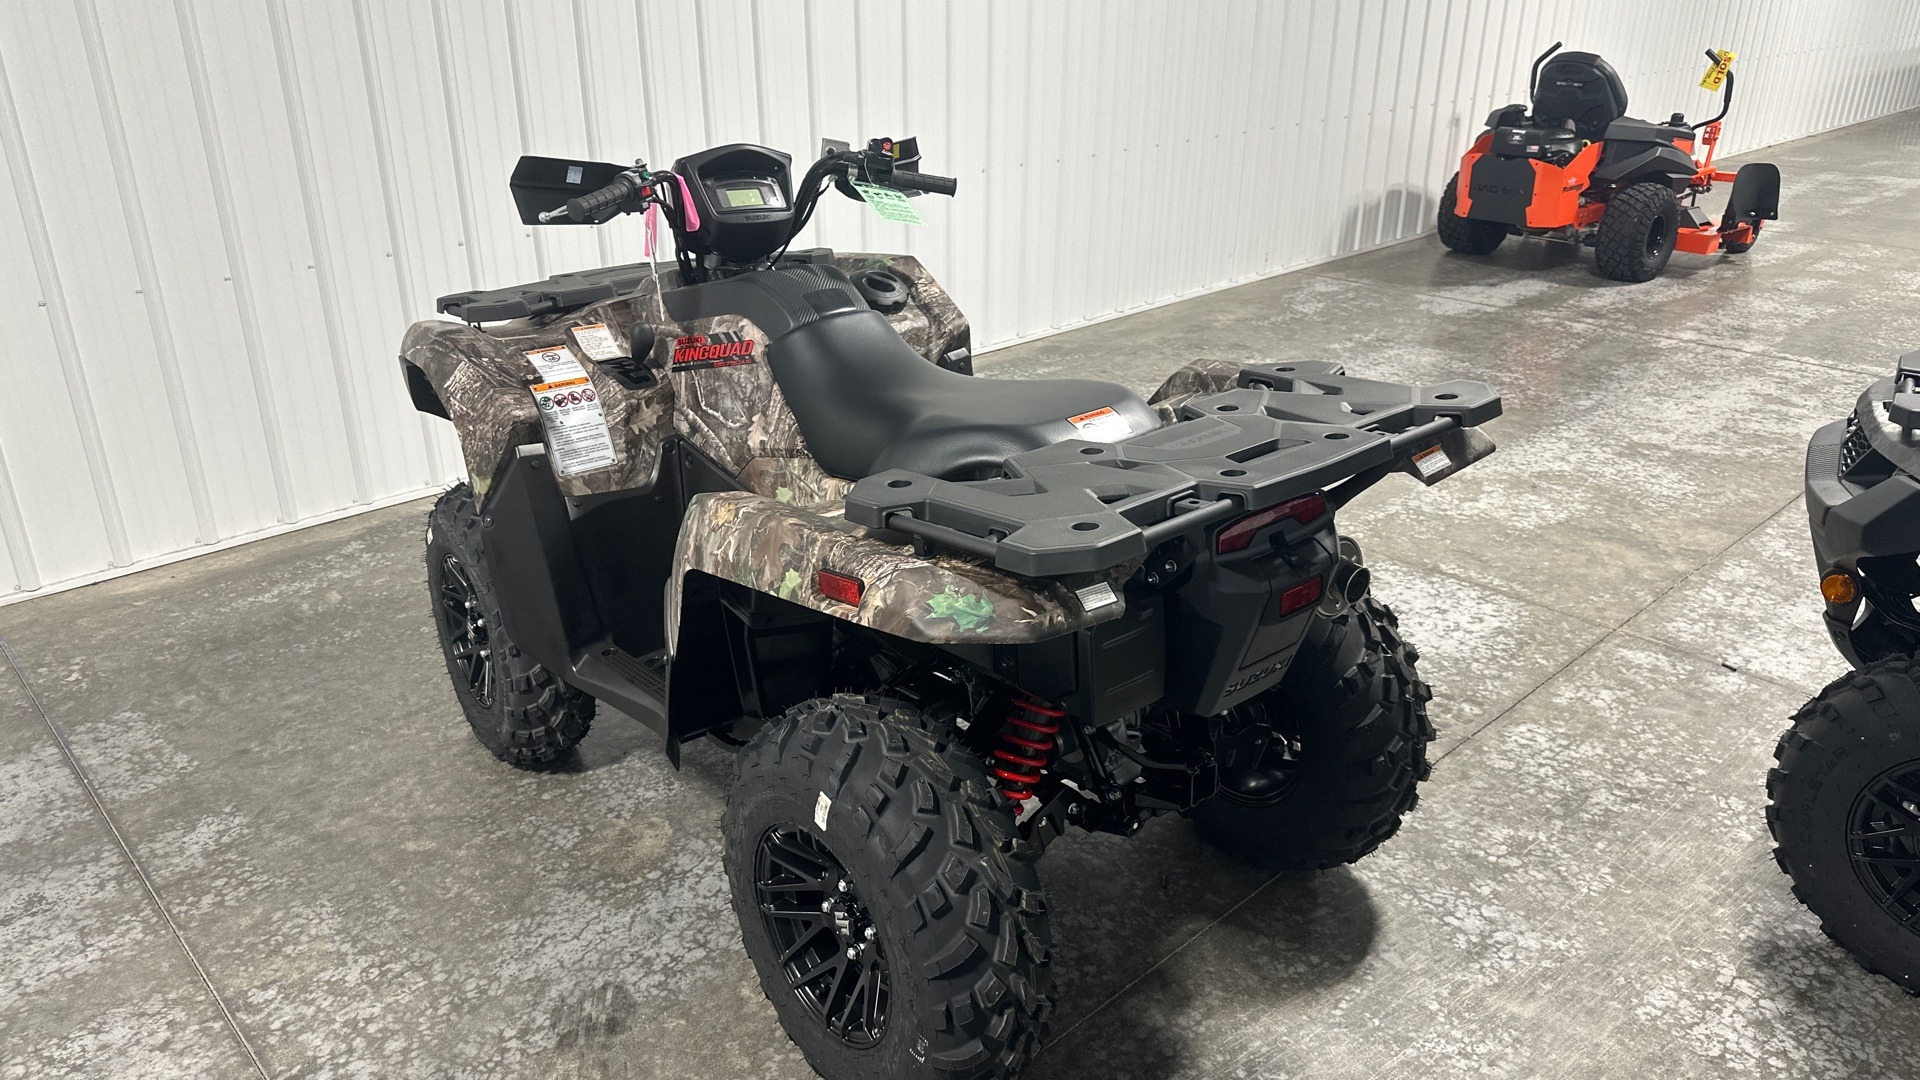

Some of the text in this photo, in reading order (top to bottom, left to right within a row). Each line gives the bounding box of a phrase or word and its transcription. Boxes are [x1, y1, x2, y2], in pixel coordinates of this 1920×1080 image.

[1712, 56, 1732, 84] SOLD
[674, 340, 754, 363] KINGQUAD
[677, 337, 704, 346] SUZUKI
[1222, 654, 1294, 698] SUZUKI
